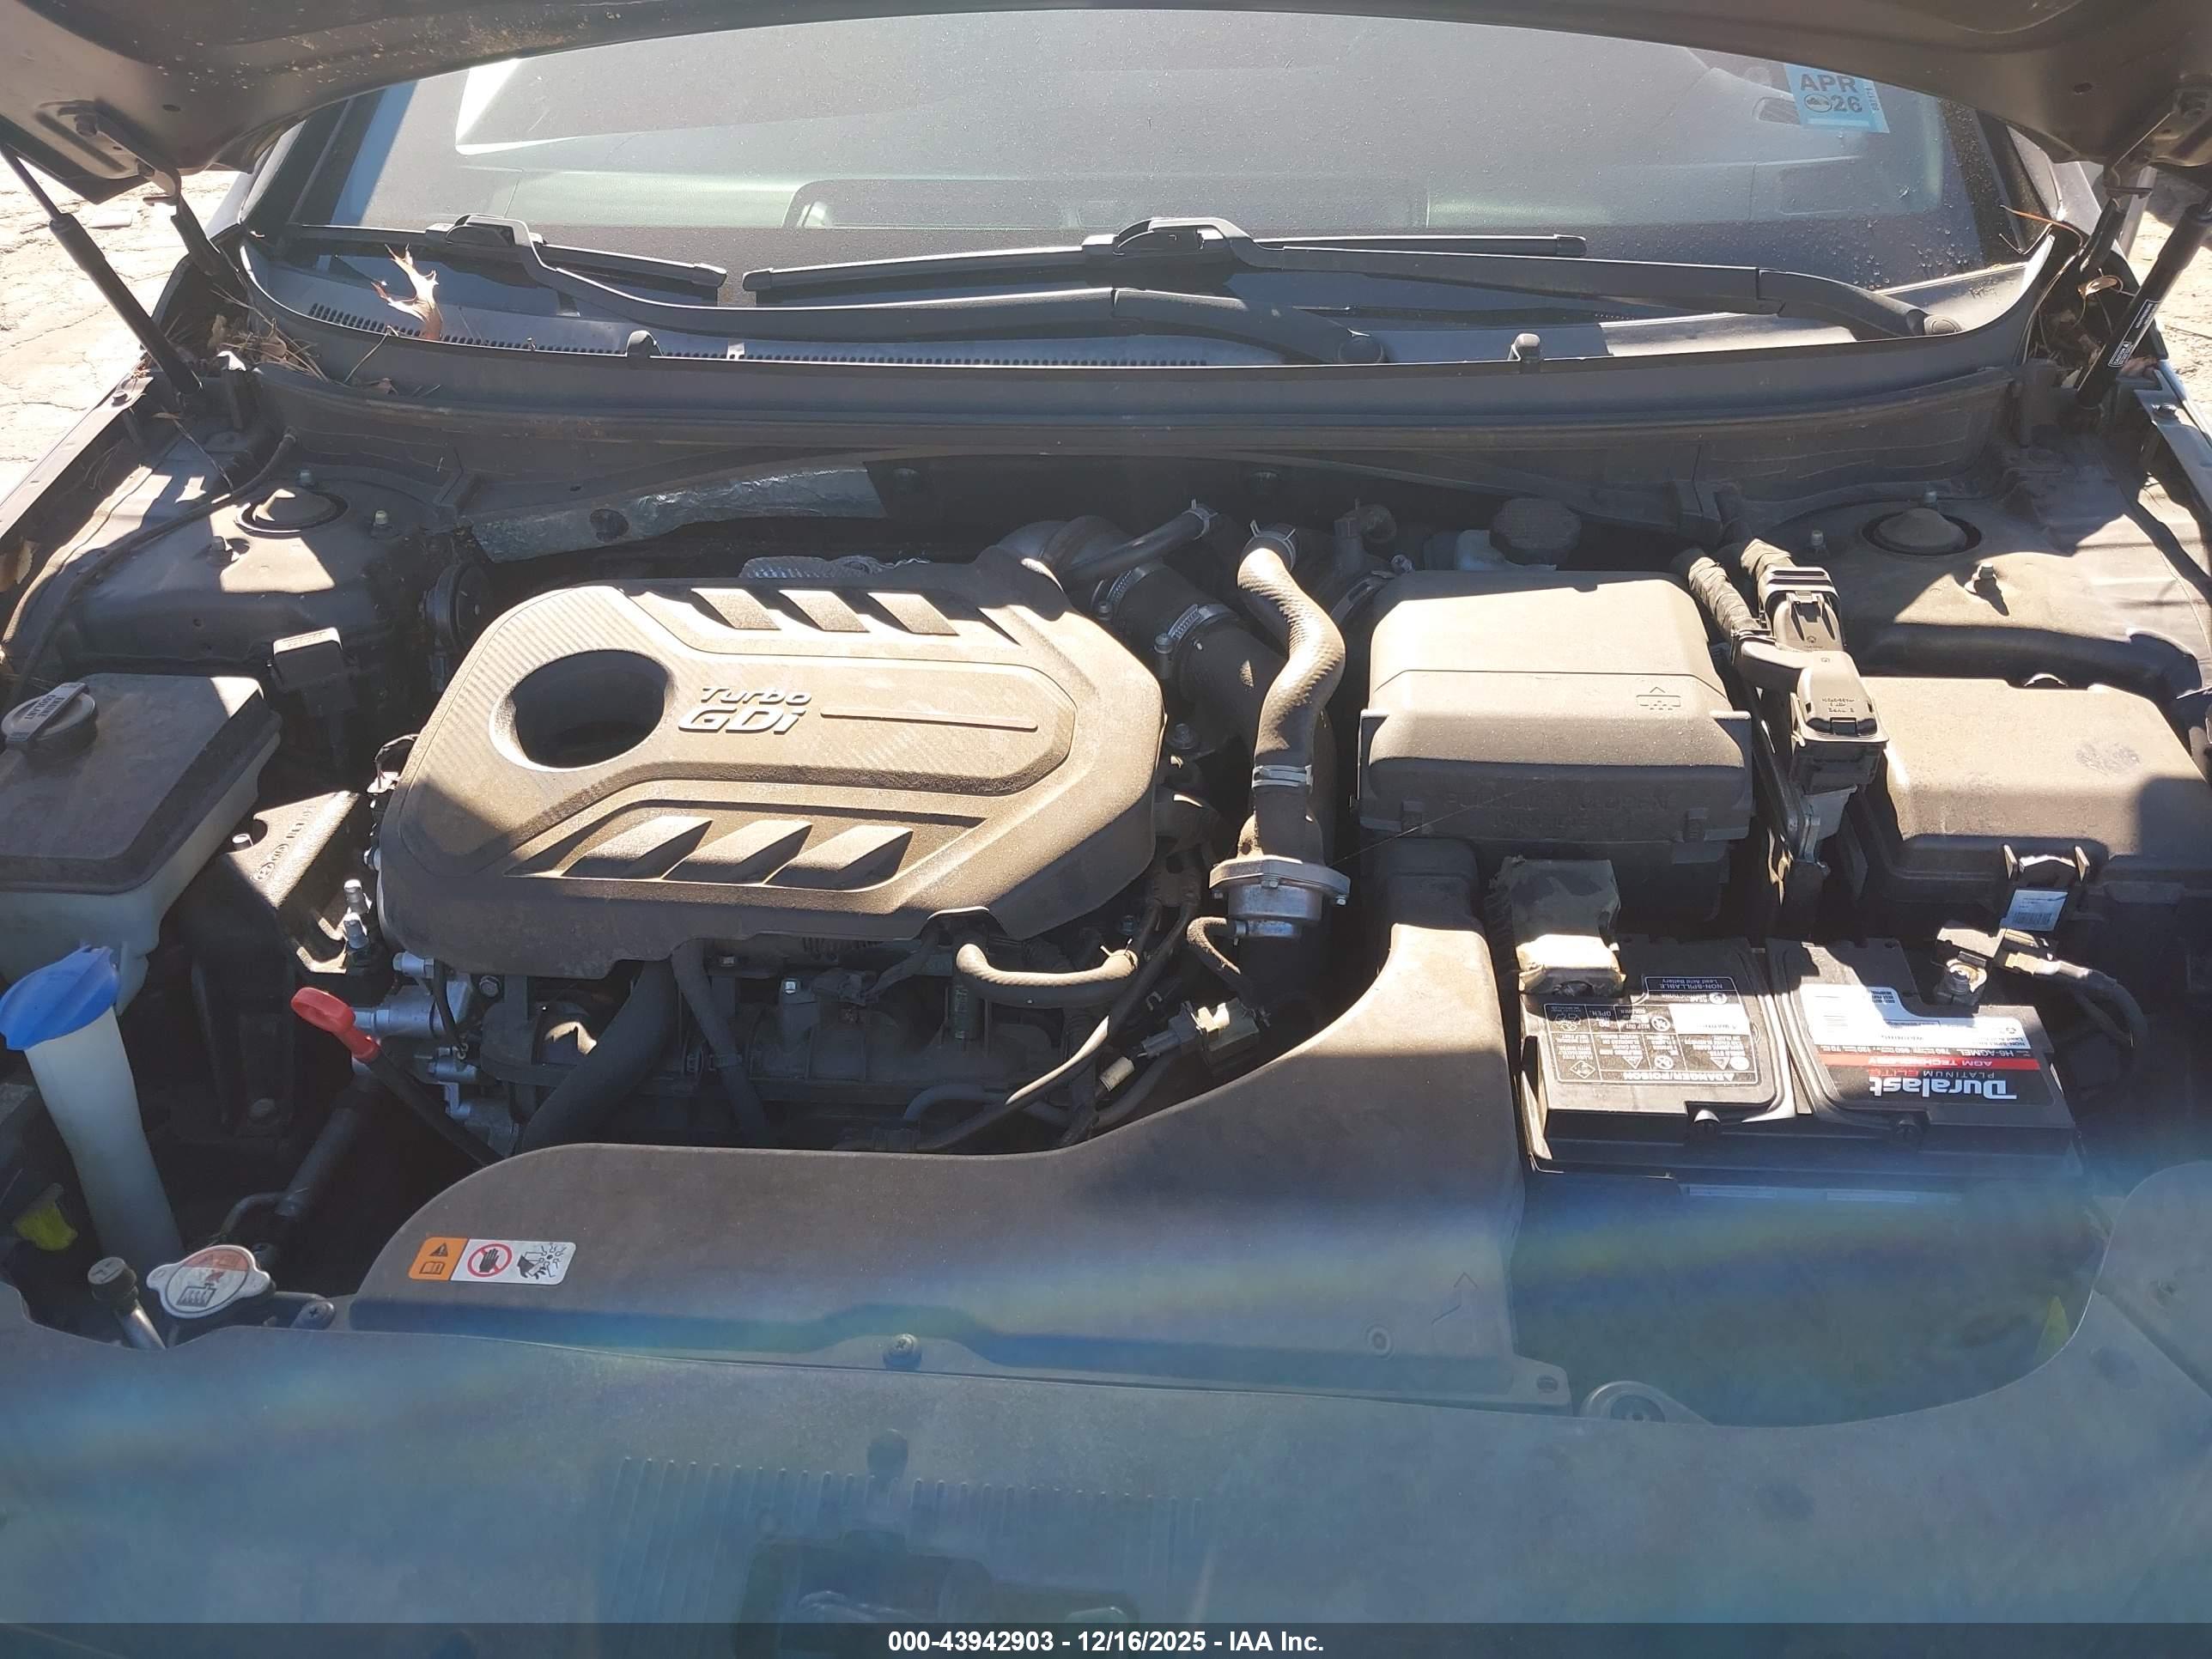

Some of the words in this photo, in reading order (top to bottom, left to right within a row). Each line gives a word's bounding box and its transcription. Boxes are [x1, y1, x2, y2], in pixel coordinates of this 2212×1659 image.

[1800, 74, 1858, 94] APR
[1831, 94, 1863, 113] 26
[700, 686, 812, 706] Turbo
[24, 694, 57, 720] COOLANT
[678, 707, 806, 736] GDi
[1868, 1069, 1919, 1078] ELITE
[1923, 1070, 1995, 1079] PLATINUM
[1869, 1076, 2018, 1100] Duralast
